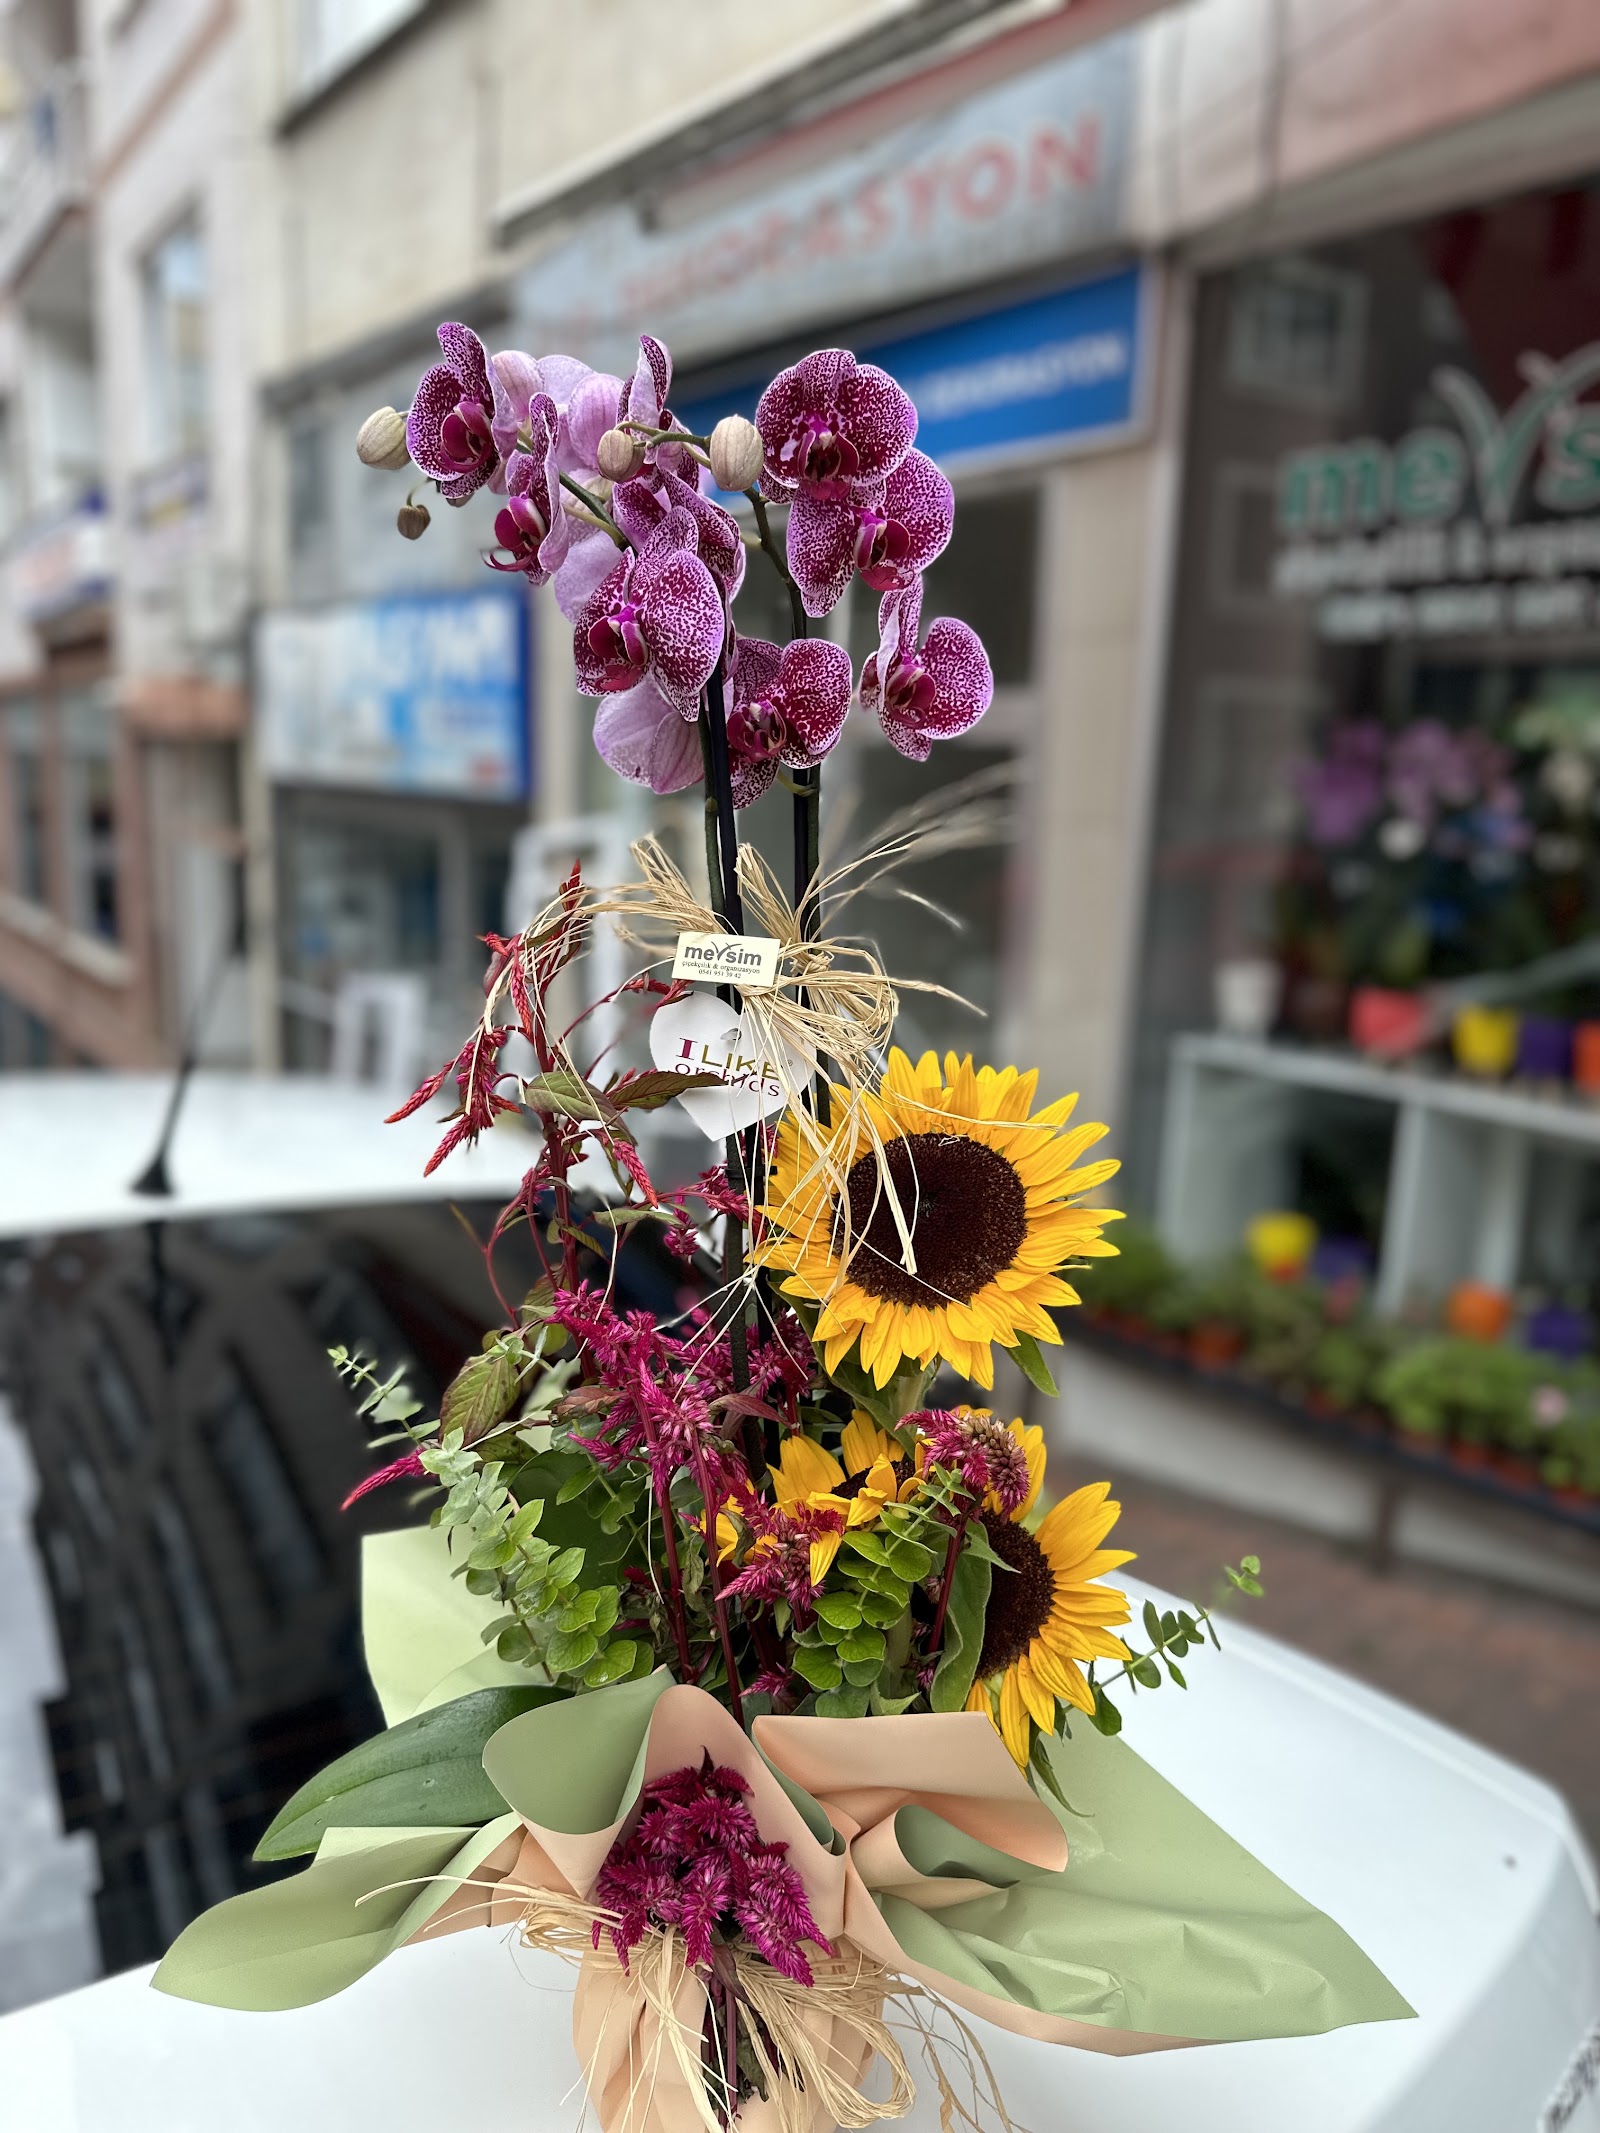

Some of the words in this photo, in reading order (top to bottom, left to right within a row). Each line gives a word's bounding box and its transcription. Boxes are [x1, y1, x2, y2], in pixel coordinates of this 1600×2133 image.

[676, 1037, 698, 1060] I
[701, 1044, 780, 1081] LIKE
[675, 1063, 780, 1097] orhids
